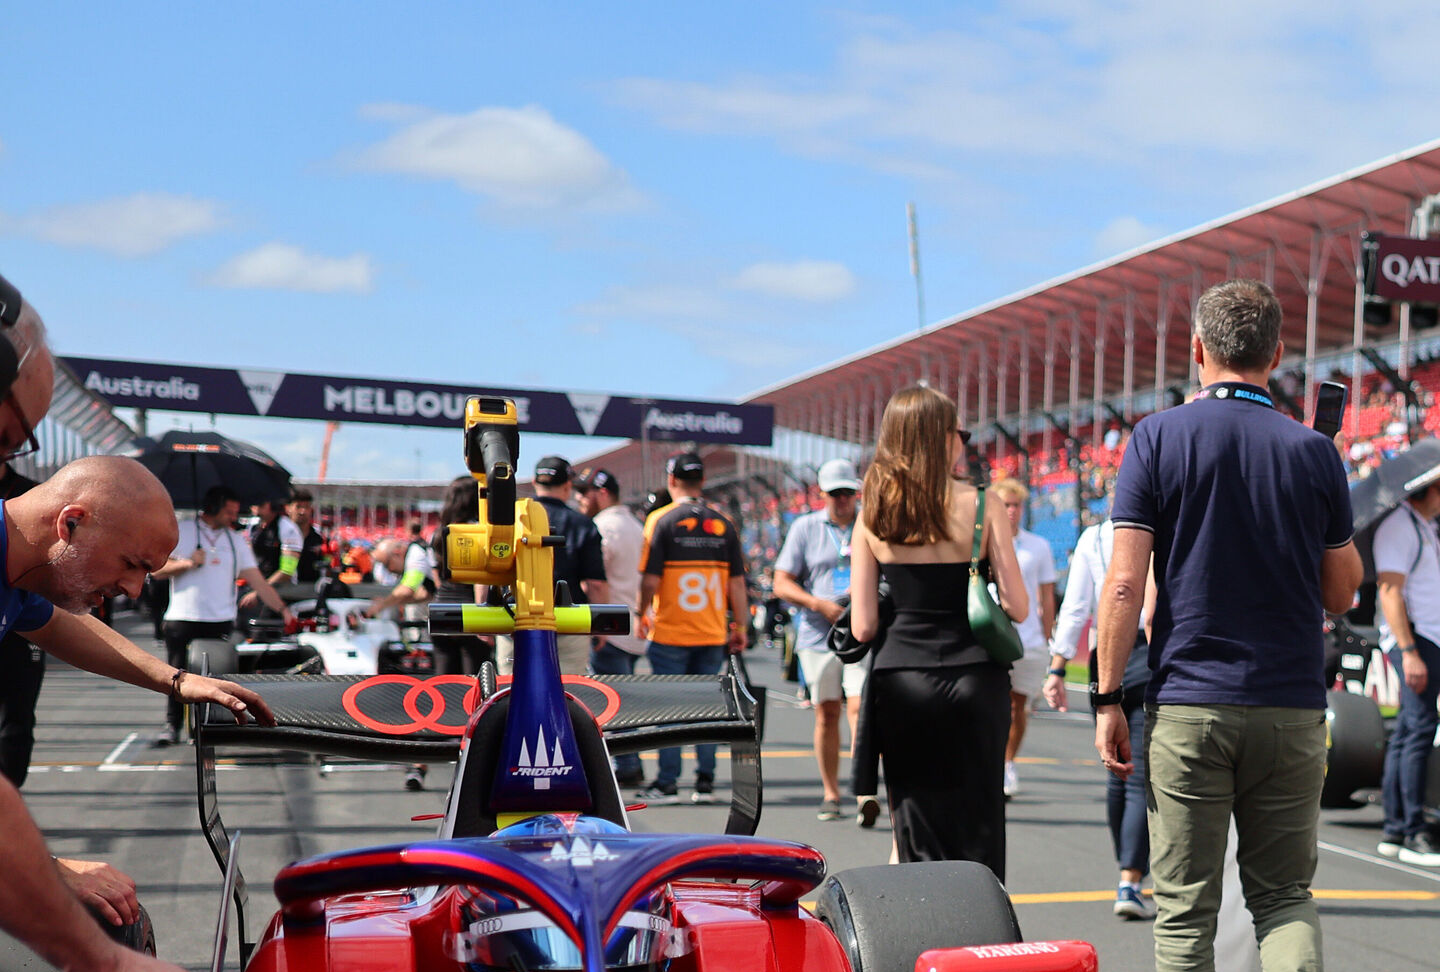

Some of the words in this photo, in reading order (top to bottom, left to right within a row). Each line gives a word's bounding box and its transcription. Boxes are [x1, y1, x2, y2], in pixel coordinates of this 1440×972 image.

[84, 369, 200, 402] Australia
[322, 384, 531, 424] MELBOUE
[646, 406, 743, 434] Australia
[493, 544, 510, 552] CAR
[677, 571, 724, 613] 81
[511, 765, 573, 776] TRIDENT
